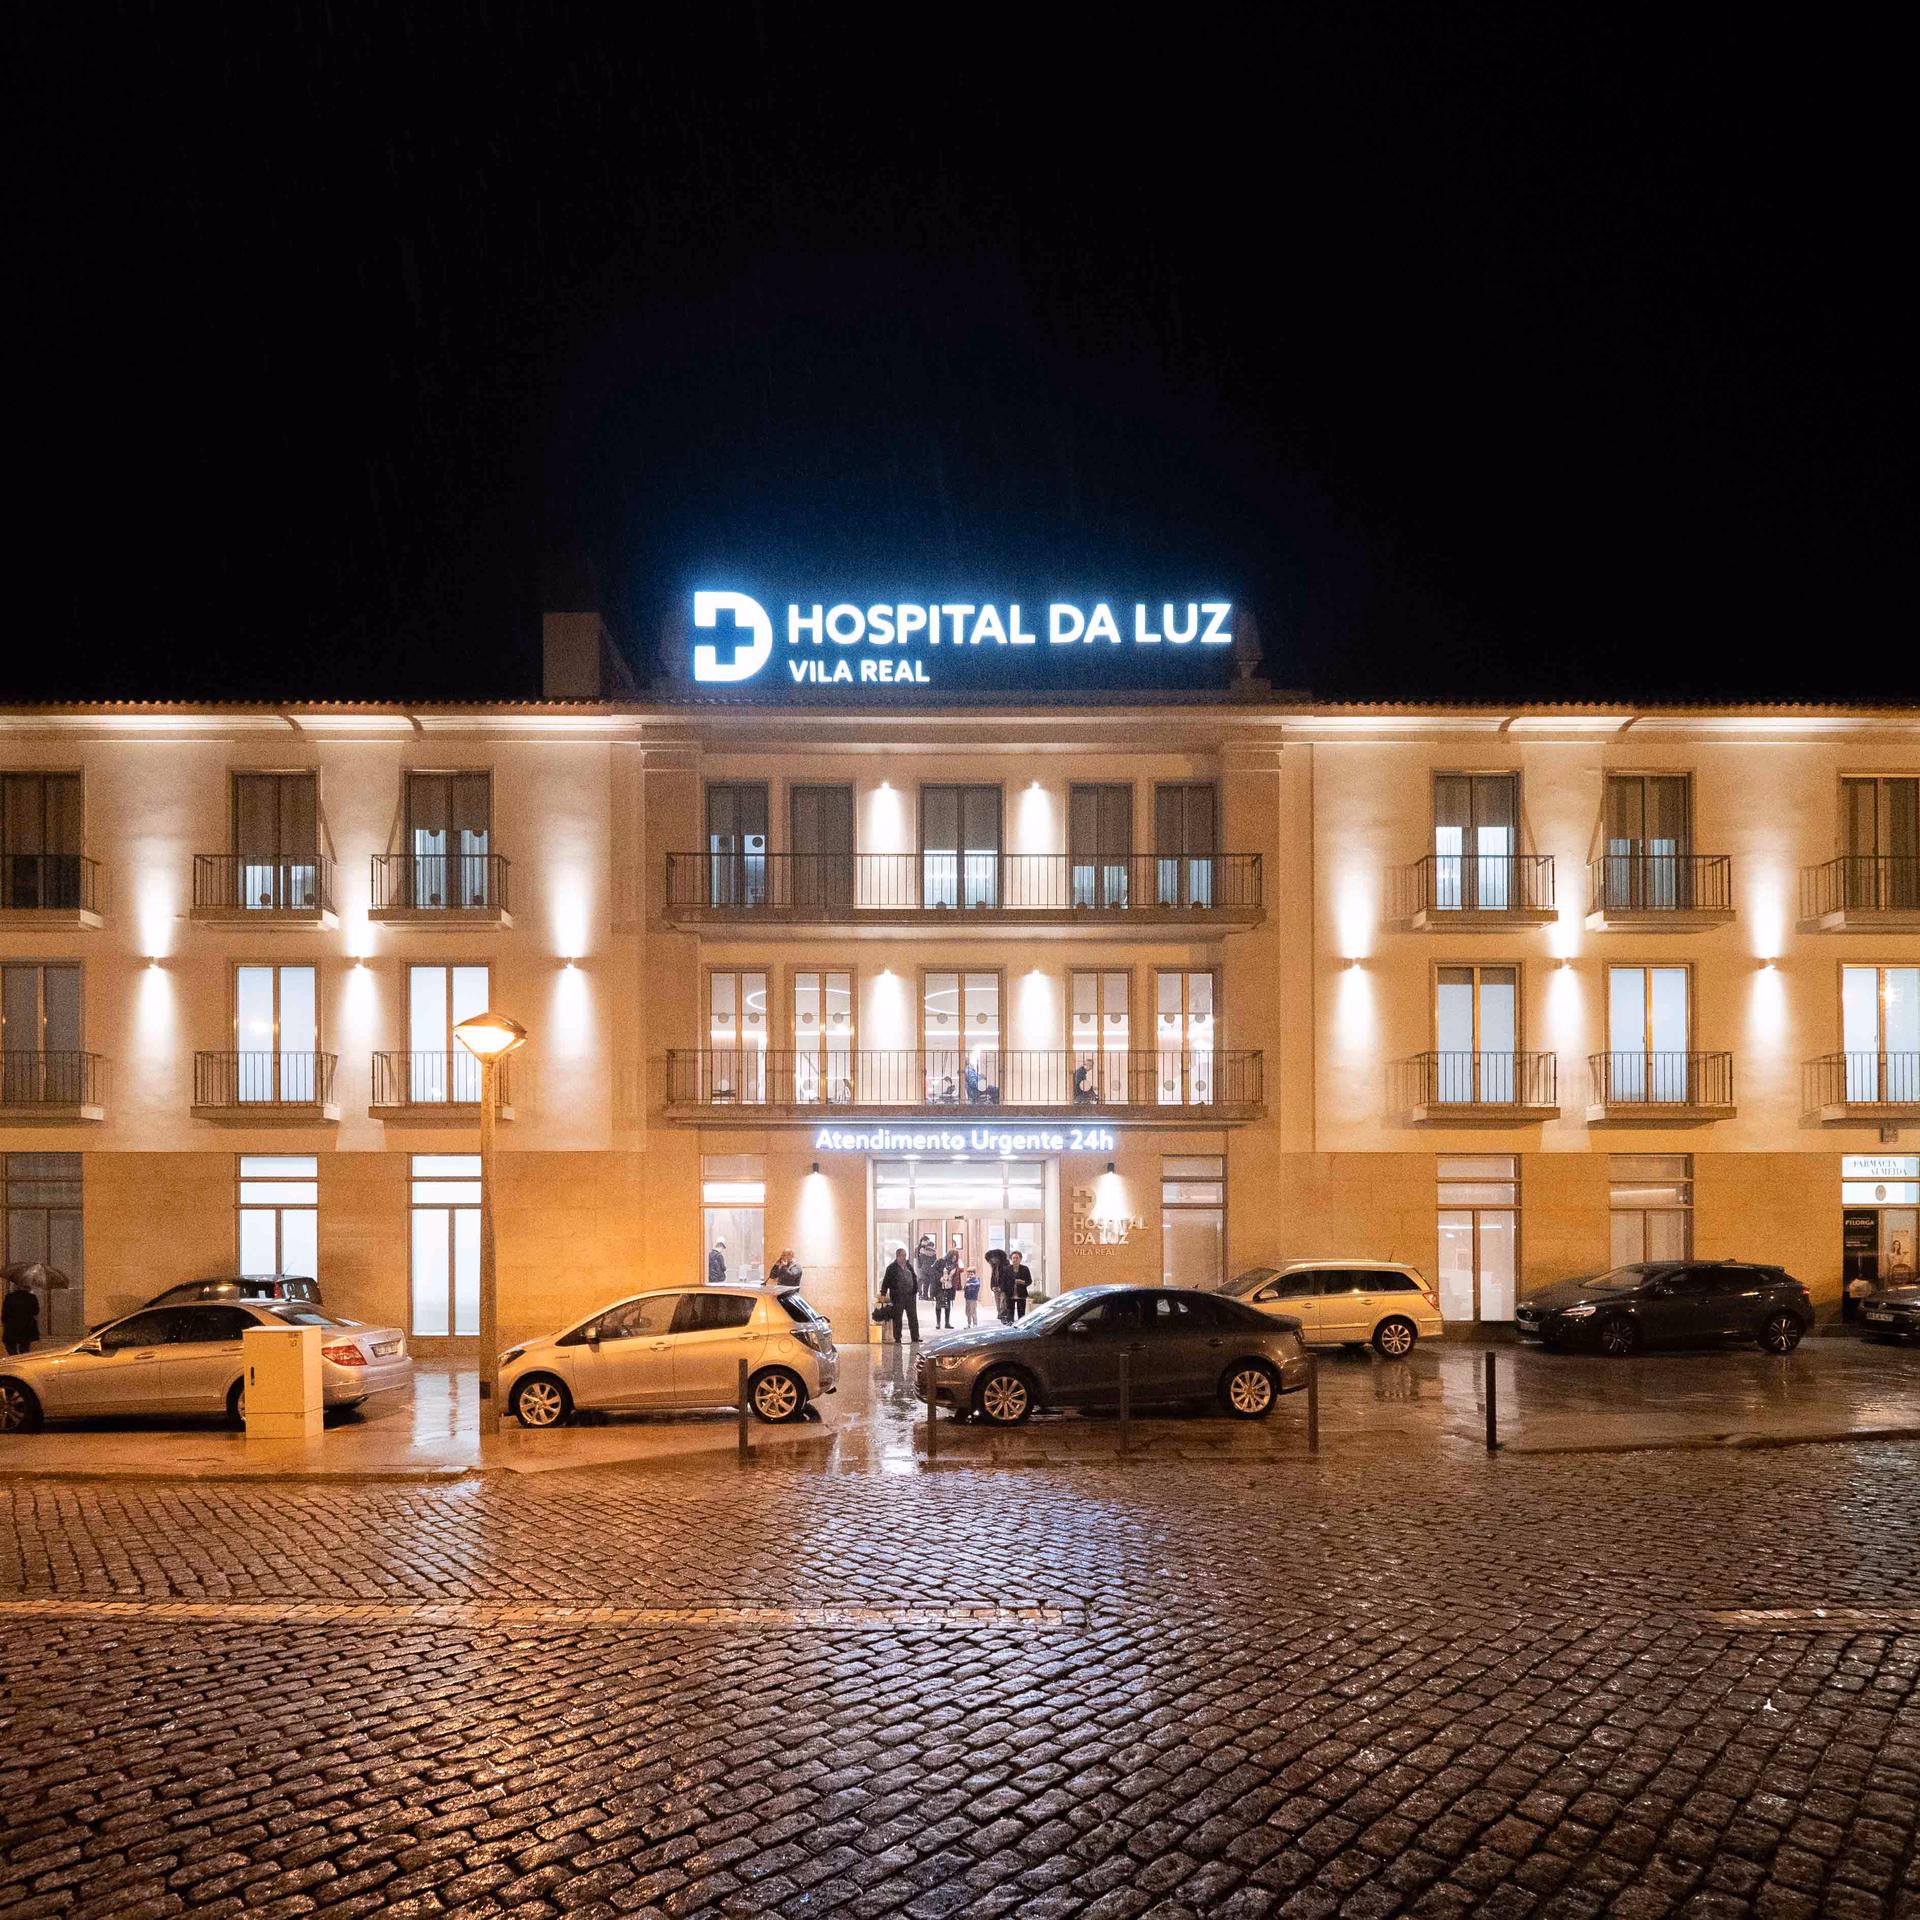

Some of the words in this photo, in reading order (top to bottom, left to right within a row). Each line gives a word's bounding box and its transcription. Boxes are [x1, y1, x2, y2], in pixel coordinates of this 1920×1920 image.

[788, 603, 1036, 645] HOSPITAL
[1049, 603, 1121, 645] DA
[1135, 603, 1232, 645] LUZ
[789, 660, 854, 683] VILA
[861, 660, 931, 683] REAL
[815, 1129, 966, 1150] Atendimento
[971, 1129, 1064, 1154] Urgente
[1069, 1129, 1114, 1151] 24h
[1073, 1232, 1096, 1245] DA
[1100, 1232, 1129, 1245] LUZ
[1073, 1248, 1094, 1256] VILA
[1096, 1248, 1117, 1256] REAL
